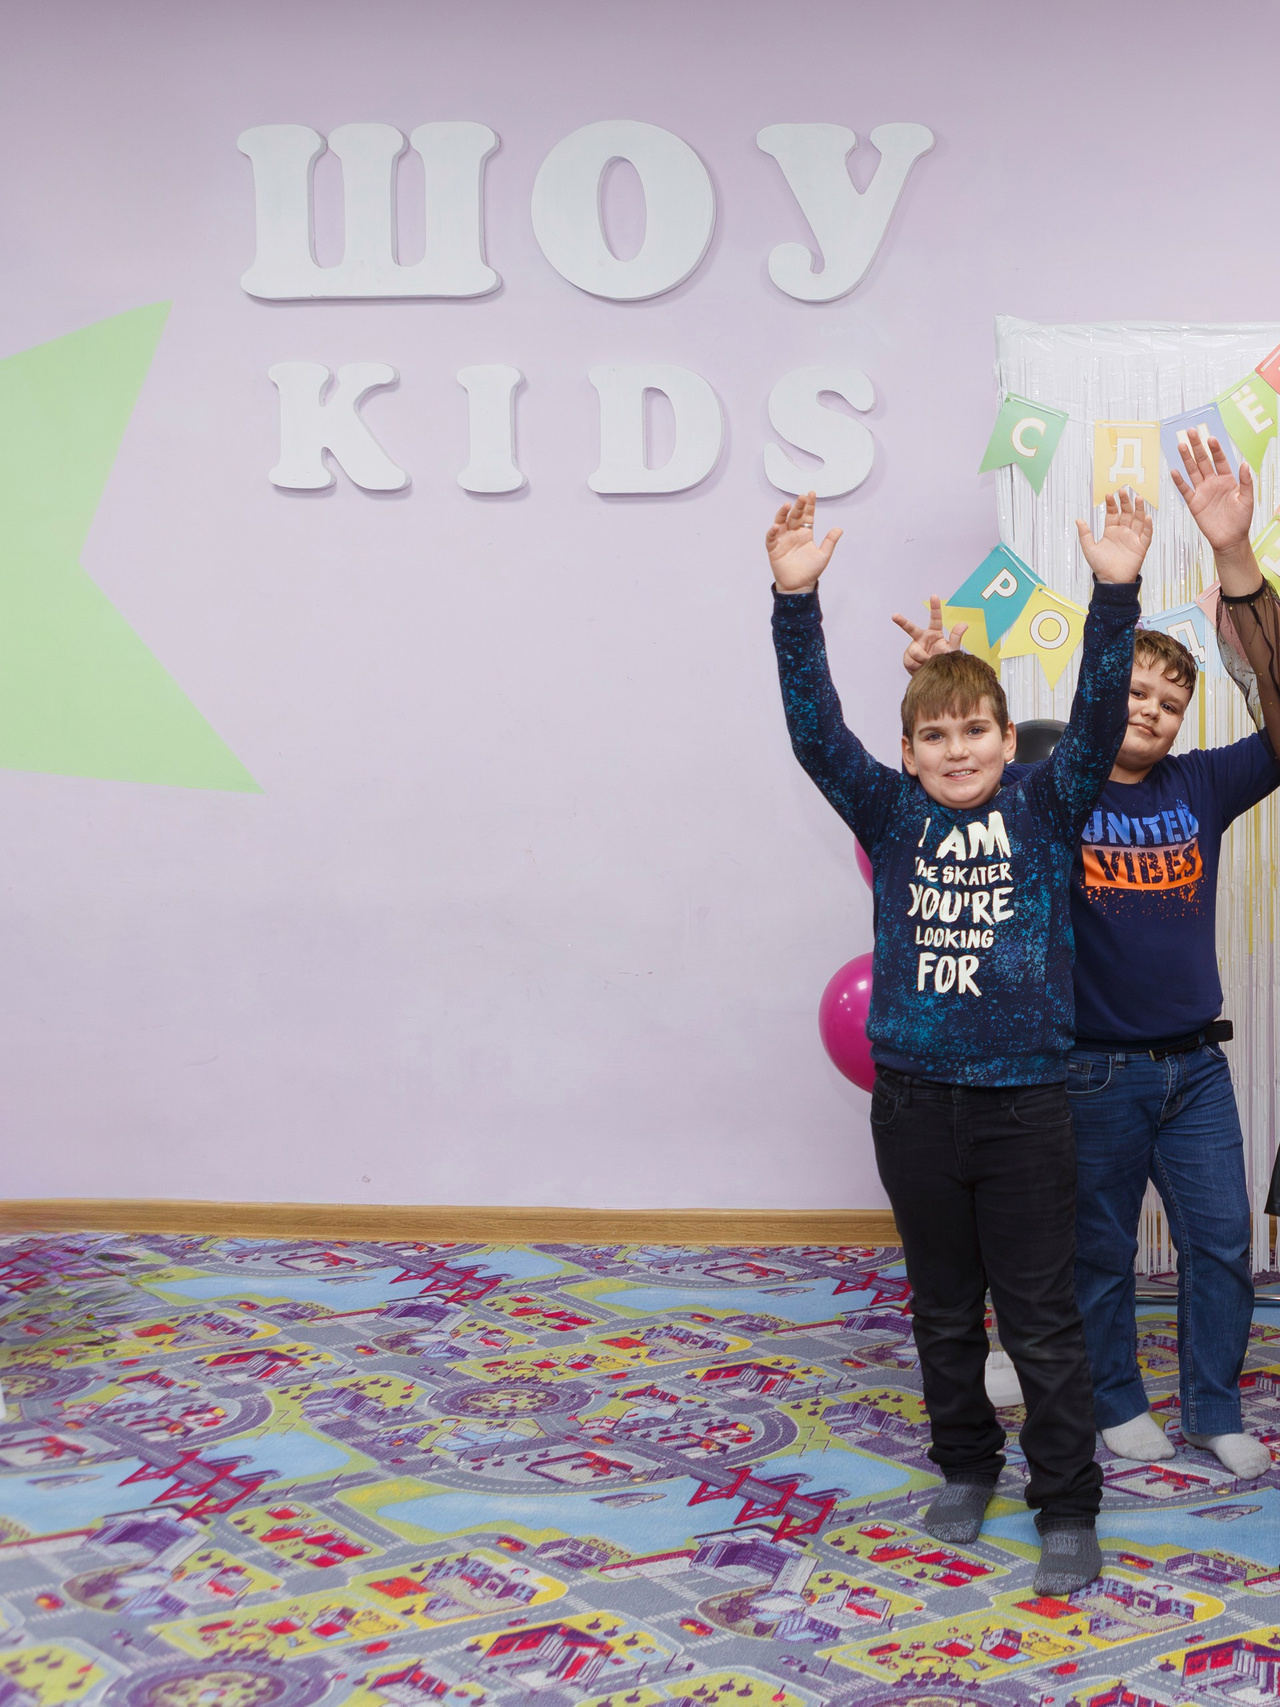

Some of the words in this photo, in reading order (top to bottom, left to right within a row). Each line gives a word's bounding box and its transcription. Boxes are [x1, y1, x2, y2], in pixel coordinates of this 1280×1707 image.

[236, 120, 937, 304] ШОУ
[267, 363, 878, 500] KIDS
[1011, 417, 1047, 458] С
[917, 817, 931, 848] I
[935, 810, 1012, 861] AM
[1081, 799, 1200, 845] UNITED
[942, 862, 1013, 886] SKATER
[1094, 842, 1198, 884] VIBES
[907, 883, 1015, 926] YOU'RE
[915, 925, 994, 949] LOOKING
[917, 952, 982, 998] FOR
